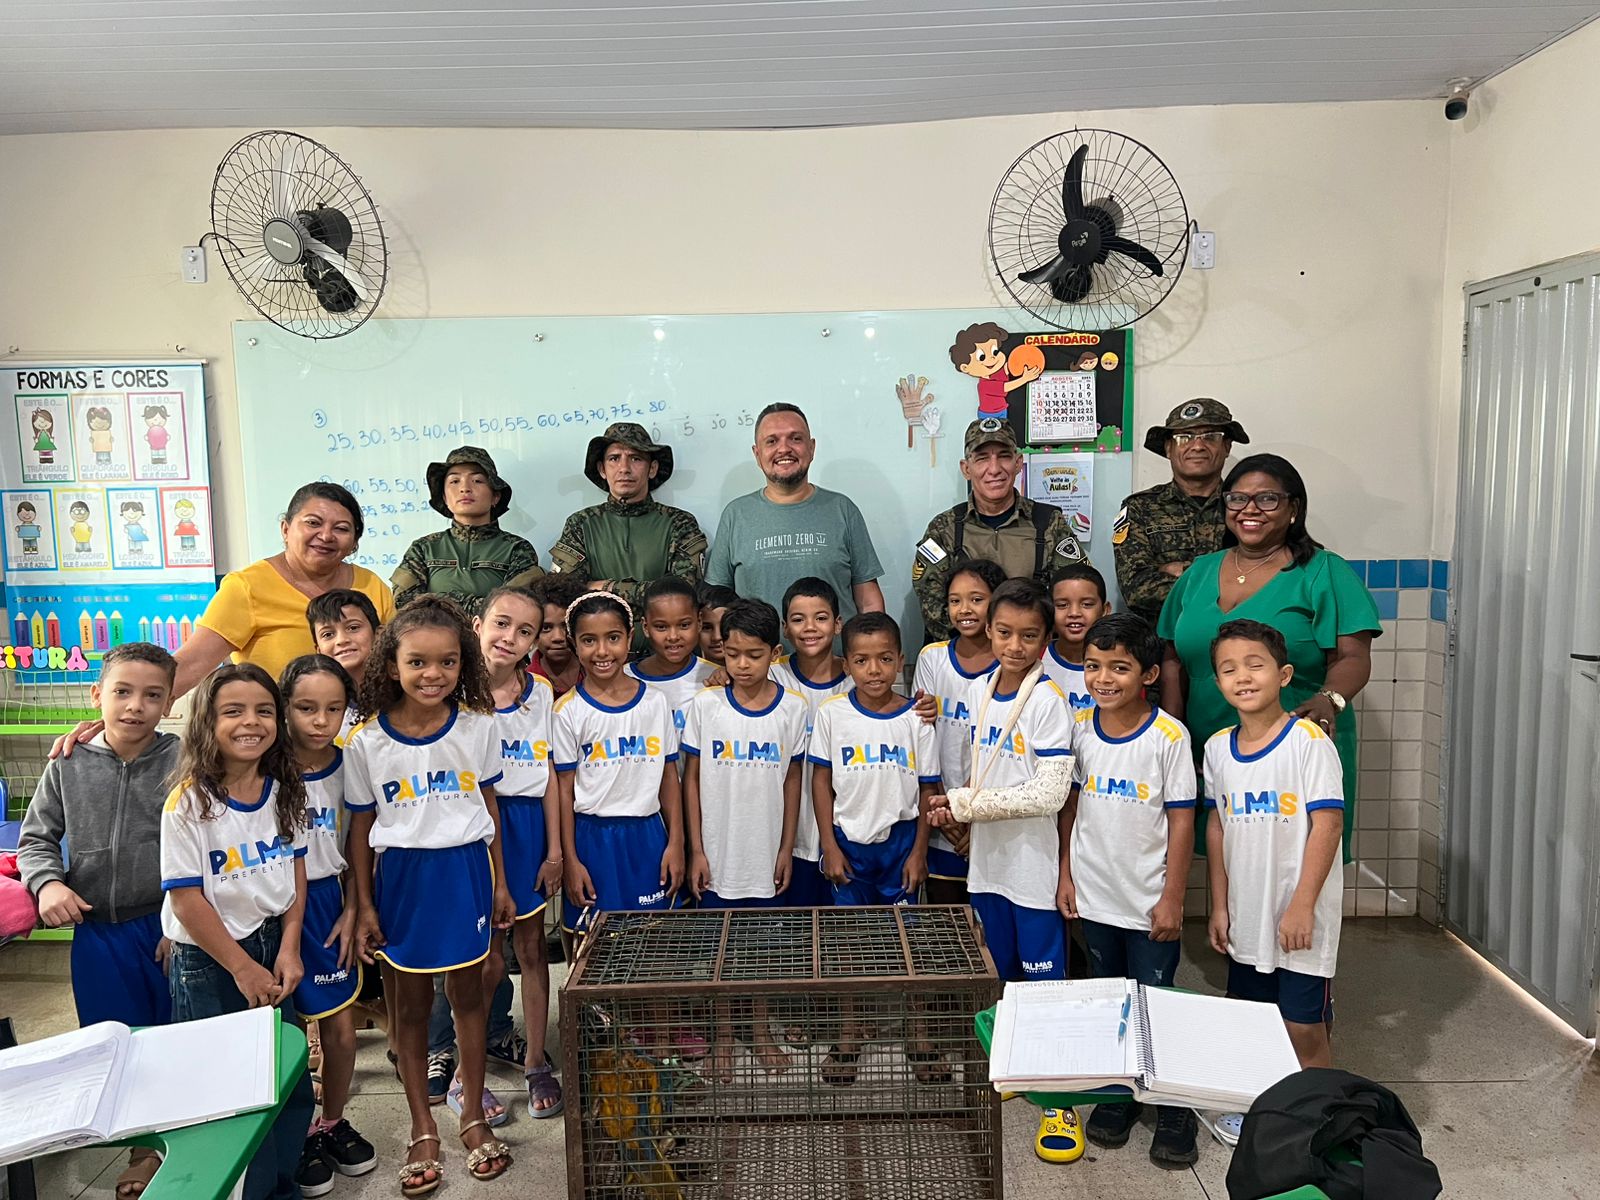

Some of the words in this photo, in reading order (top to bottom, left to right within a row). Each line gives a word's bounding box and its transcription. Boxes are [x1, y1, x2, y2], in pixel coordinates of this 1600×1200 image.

[17, 371, 87, 389] FORMAS
[94, 370, 105, 388] E
[111, 370, 168, 387] CORES
[328, 433, 354, 452] 25,
[359, 429, 385, 447] 30,
[390, 425, 419, 441] 35,
[422, 424, 446, 439] 40,
[447, 421, 474, 435] 45,
[479, 418, 503, 433] 50,
[610, 404, 632, 418] 75
[684, 422, 695, 437] 5
[1049, 483, 1071, 491] Aulas!
[368, 528, 377, 538] 5
[392, 524, 401, 536] 0
[755, 534, 792, 551] ELEMENTO
[795, 533, 814, 545] ZERO
[501, 739, 548, 761] MAS
[581, 735, 661, 762] PALMAS
[585, 757, 656, 768] PREFEITURA
[717, 759, 780, 769] PREFEITUR
[382, 769, 476, 803] PALMAS
[1083, 774, 1150, 800] ALMAS
[394, 792, 470, 809] PREFEITURA
[209, 835, 295, 876] PALMA
[1022, 960, 1053, 971] PALMAS
